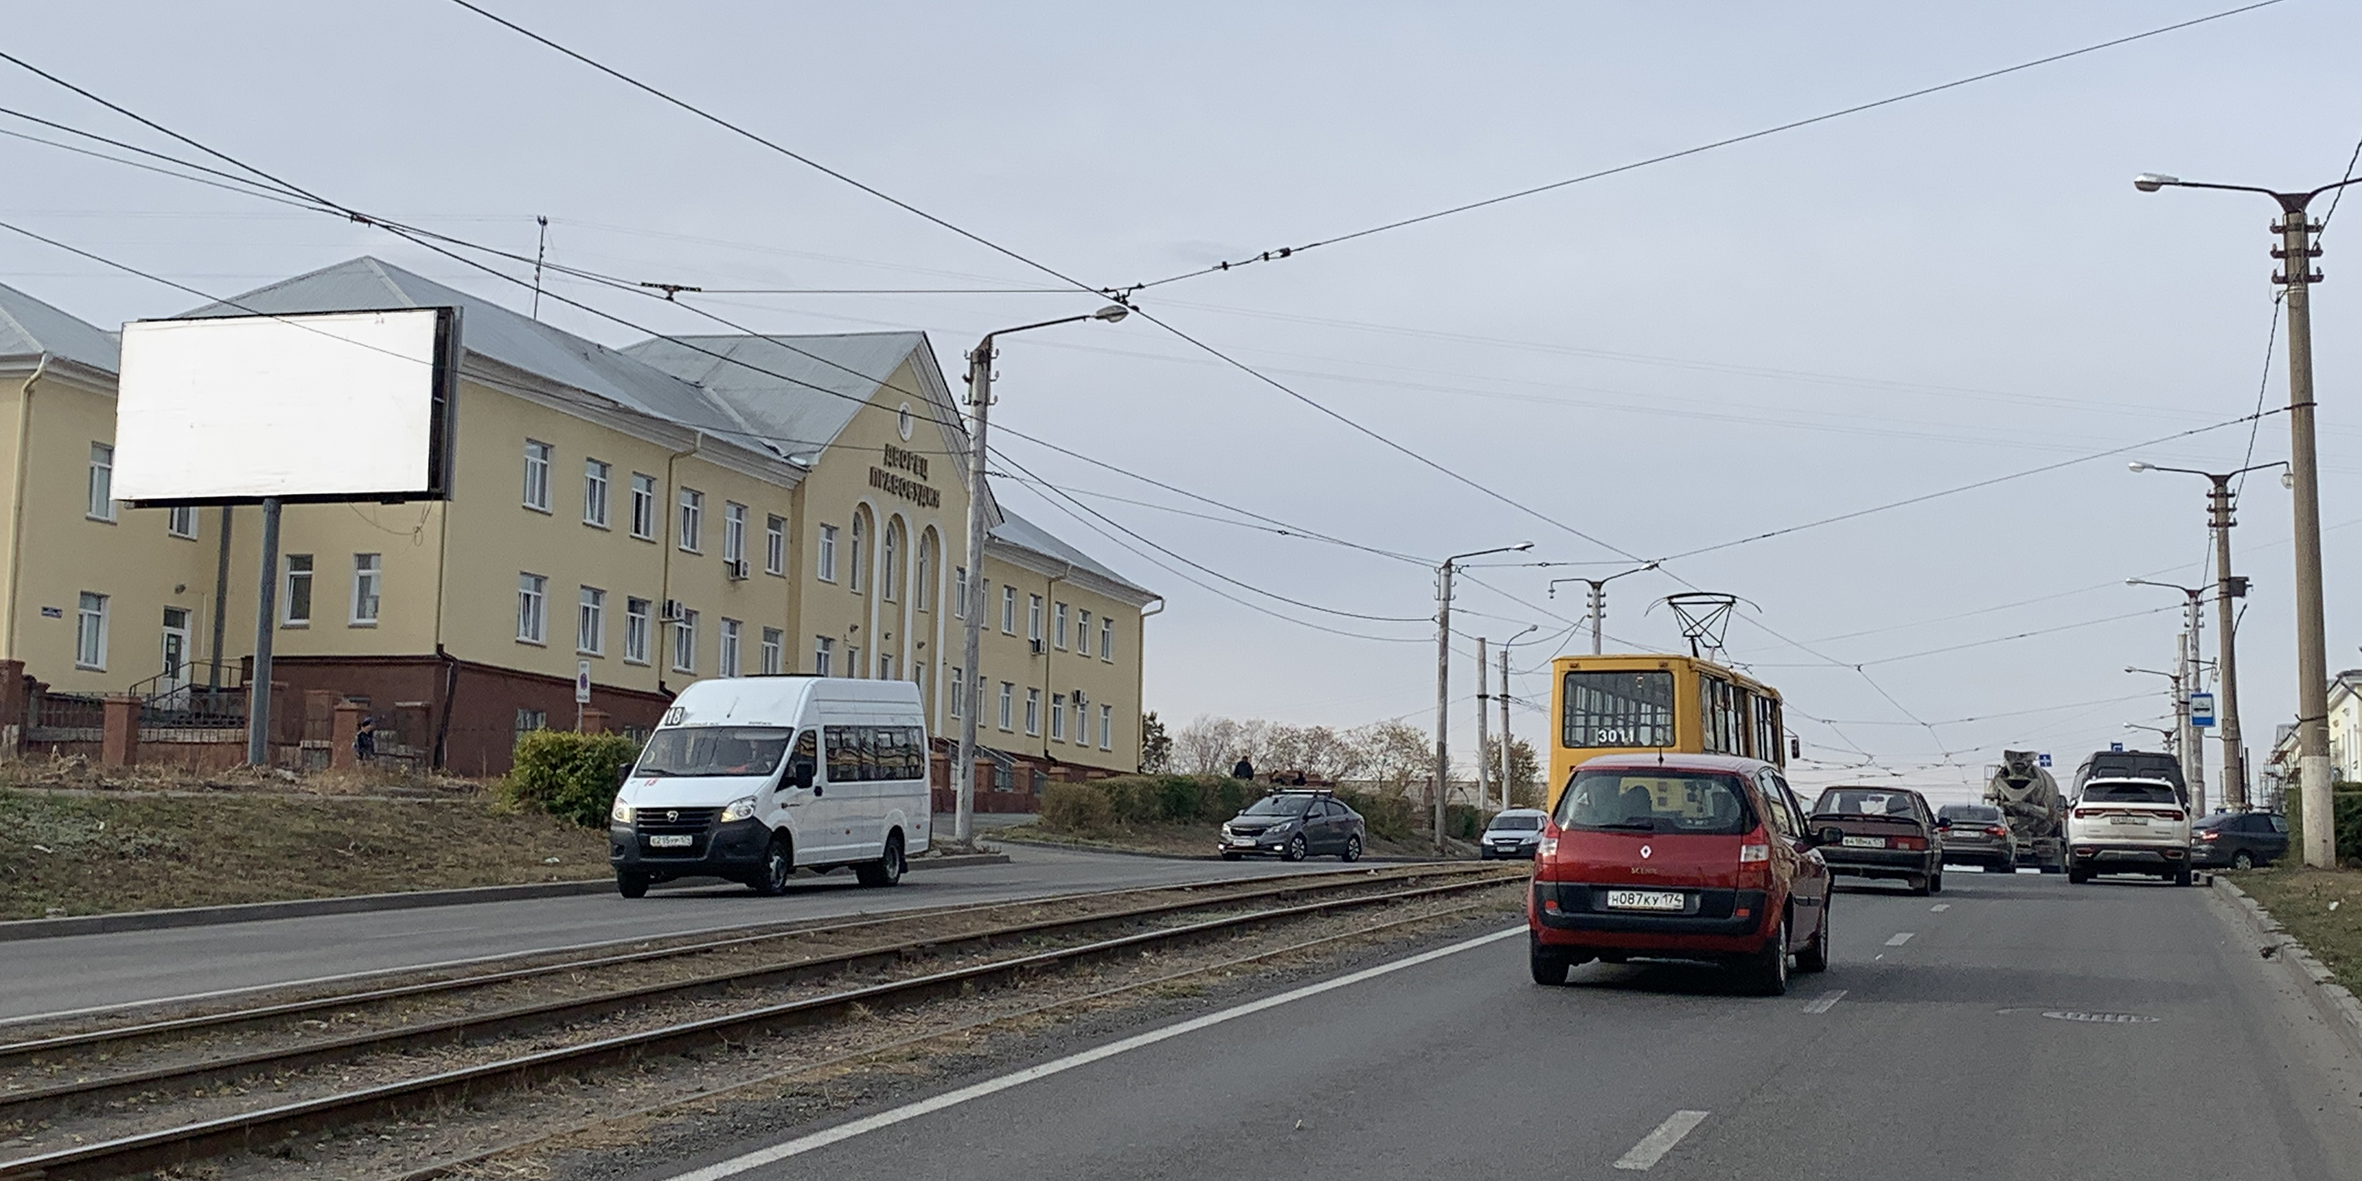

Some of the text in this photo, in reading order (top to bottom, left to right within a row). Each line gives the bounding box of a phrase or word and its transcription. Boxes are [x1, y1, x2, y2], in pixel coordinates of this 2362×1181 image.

[883, 443, 928, 481] ДВОРЕЦ
[869, 466, 941, 509] ПРАВОСУДИЯ
[667, 707, 683, 725] 18
[1598, 729, 1634, 743] 3011
[1662, 893, 1682, 904] 174
